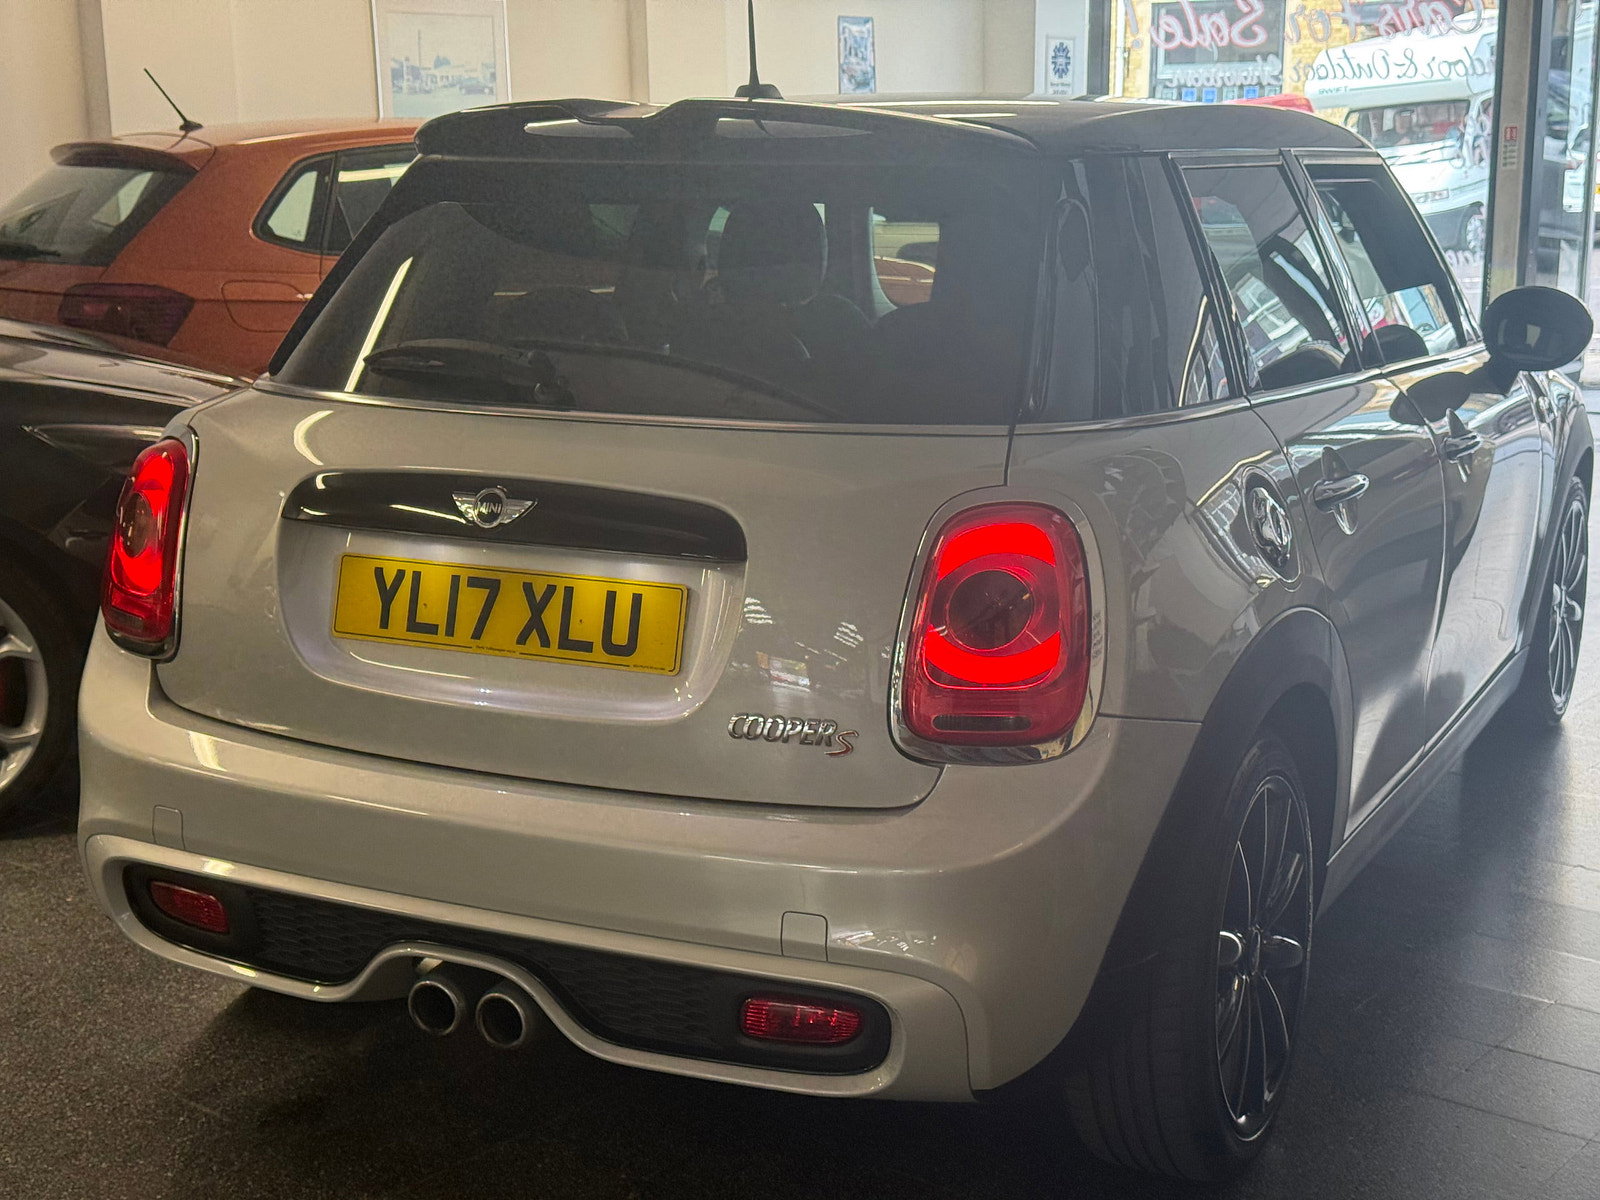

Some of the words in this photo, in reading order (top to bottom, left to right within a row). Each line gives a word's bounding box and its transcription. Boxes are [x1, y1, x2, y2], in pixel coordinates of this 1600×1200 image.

[475, 501, 503, 515] MINI
[373, 566, 501, 641] YL17
[515, 581, 643, 657] XLU
[728, 713, 838, 747] COOPER
[824, 730, 859, 758] S
